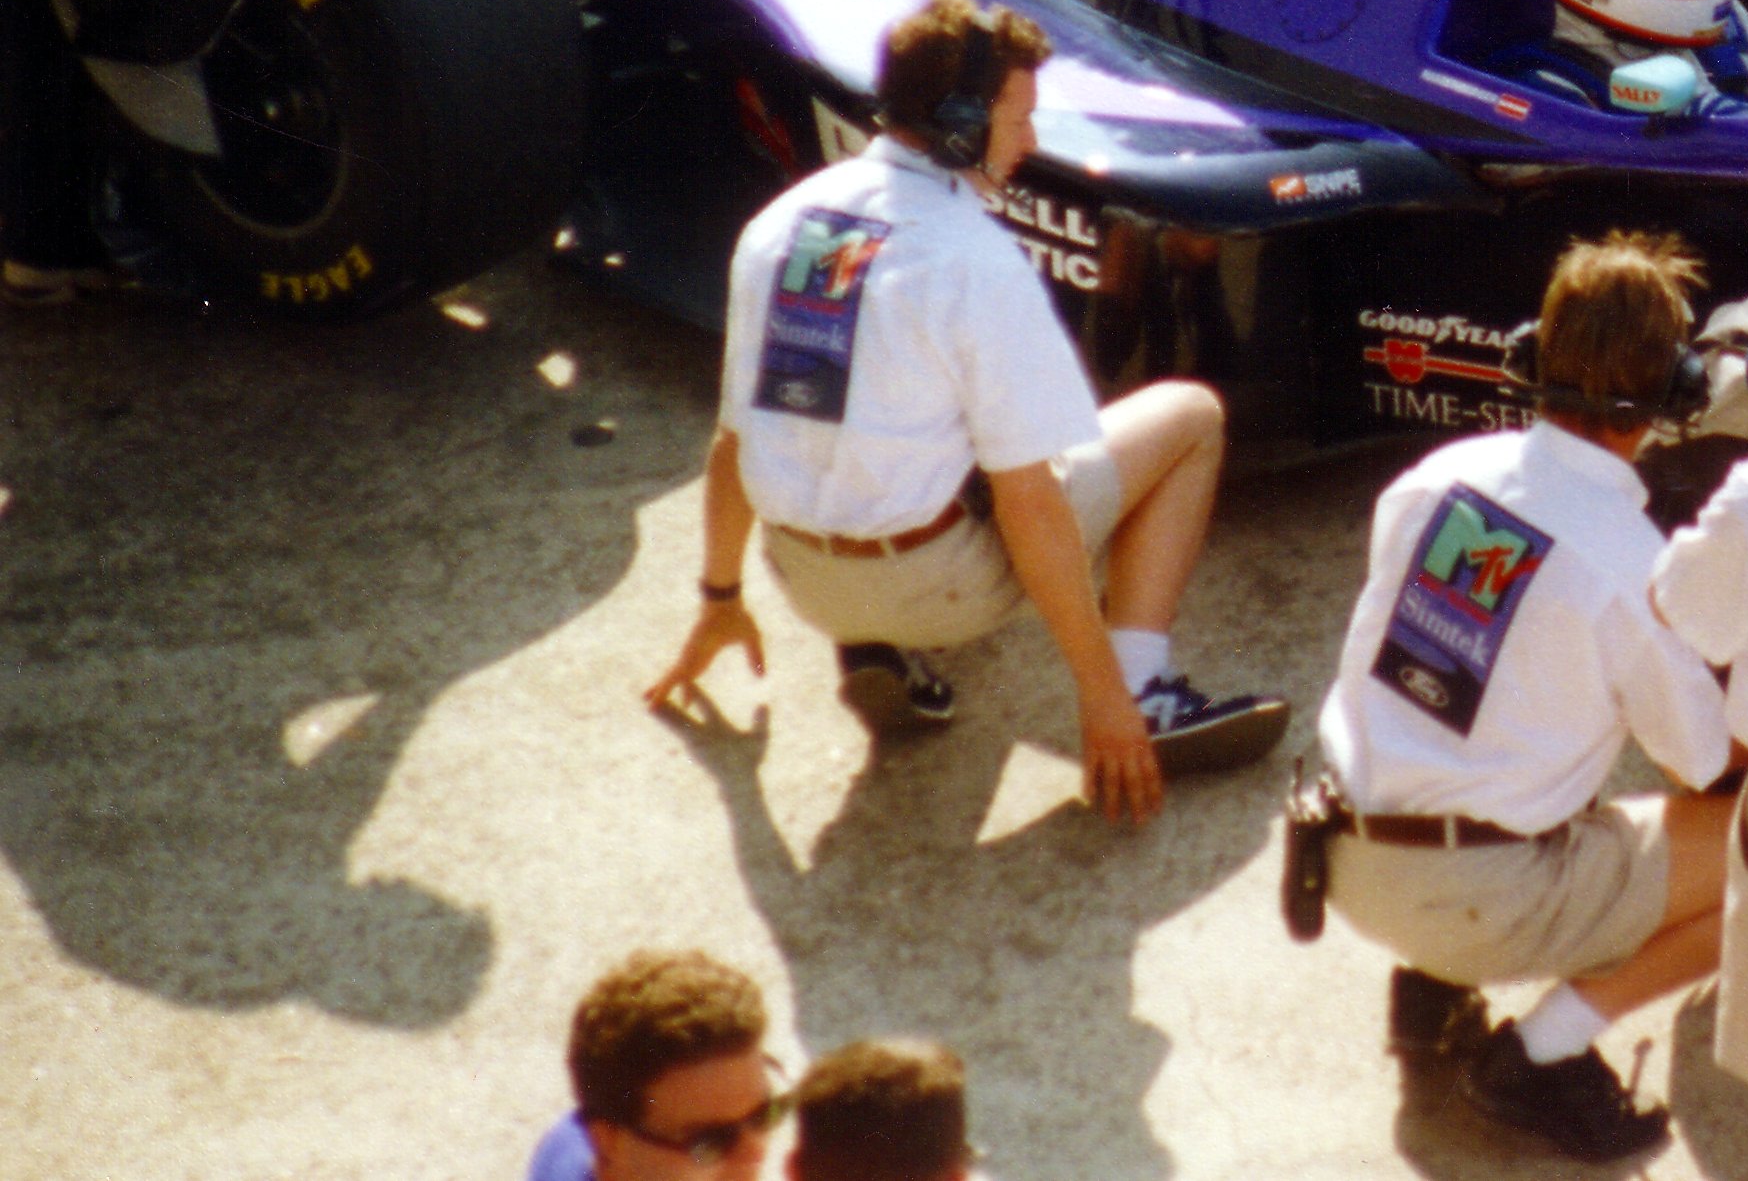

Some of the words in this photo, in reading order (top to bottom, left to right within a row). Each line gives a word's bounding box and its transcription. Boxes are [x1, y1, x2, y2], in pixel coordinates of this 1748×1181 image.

[782, 220, 885, 301] MTV
[1358, 309, 1514, 349] GOODYEA
[1423, 500, 1546, 612] MTV
[1402, 587, 1489, 667] Simtek
